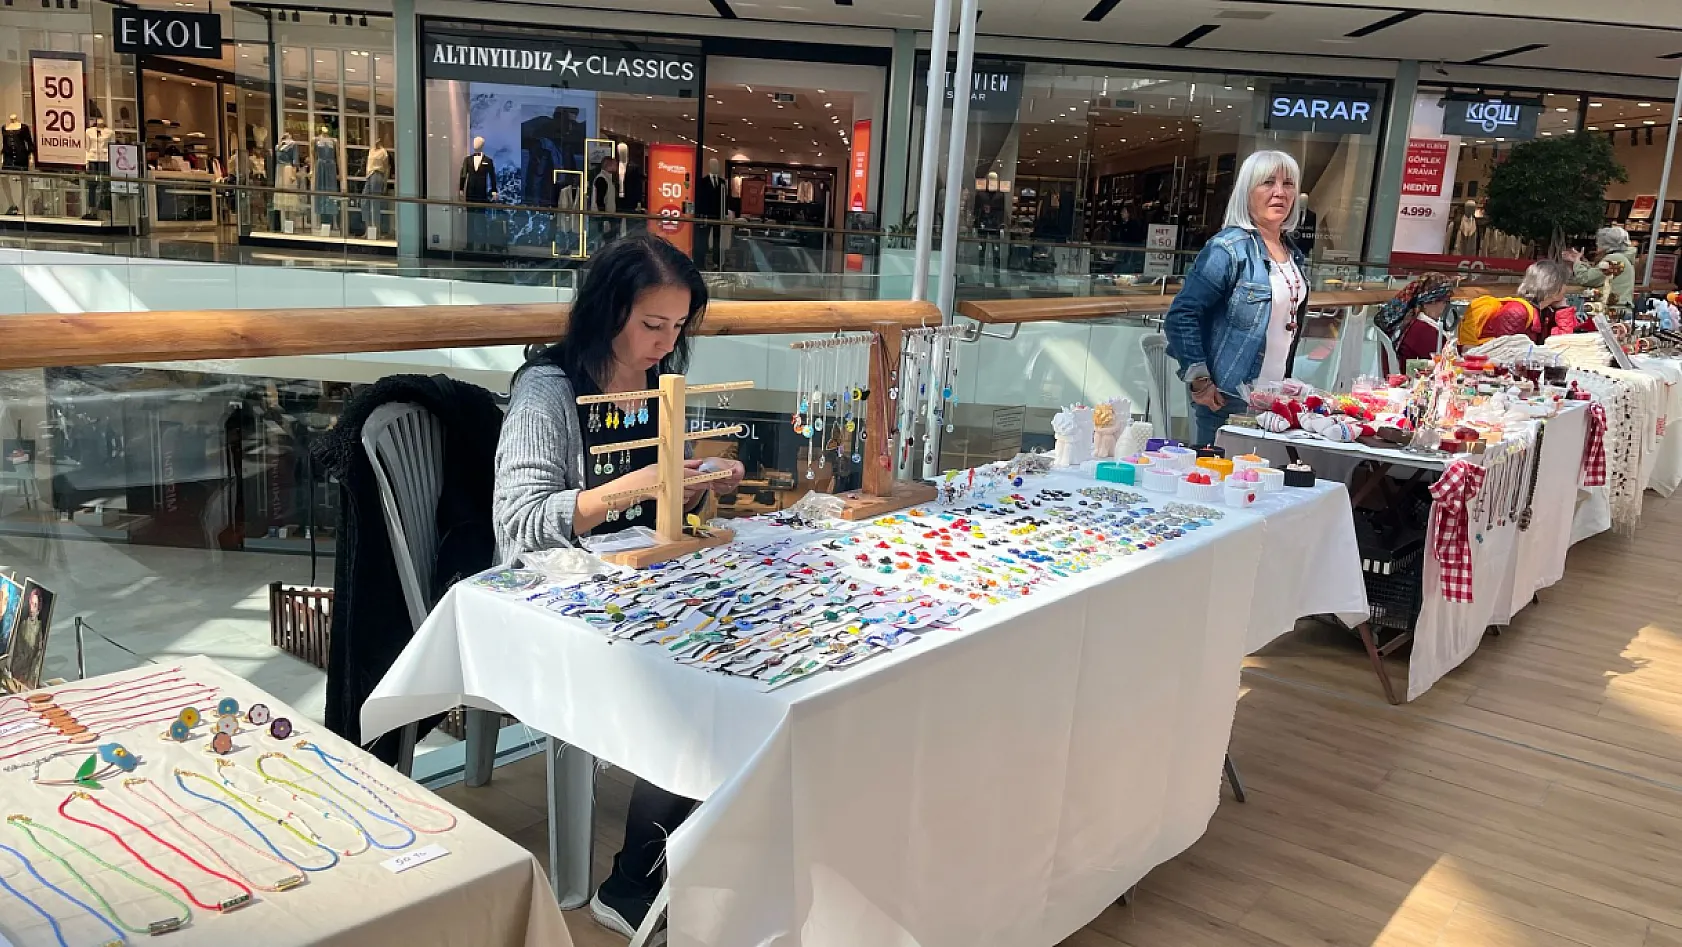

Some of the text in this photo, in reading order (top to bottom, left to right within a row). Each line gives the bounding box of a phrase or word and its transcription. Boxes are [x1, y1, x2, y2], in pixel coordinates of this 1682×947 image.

[121, 17, 214, 50] EKOL
[432, 43, 694, 81] ALTINYILDIZ CLASSICS
[1271, 97, 1371, 122] SARAR
[41, 134, 81, 149] İNDİRİM
[1407, 168, 1438, 176] KRAVAT
[1402, 182, 1438, 193] HEDİYE
